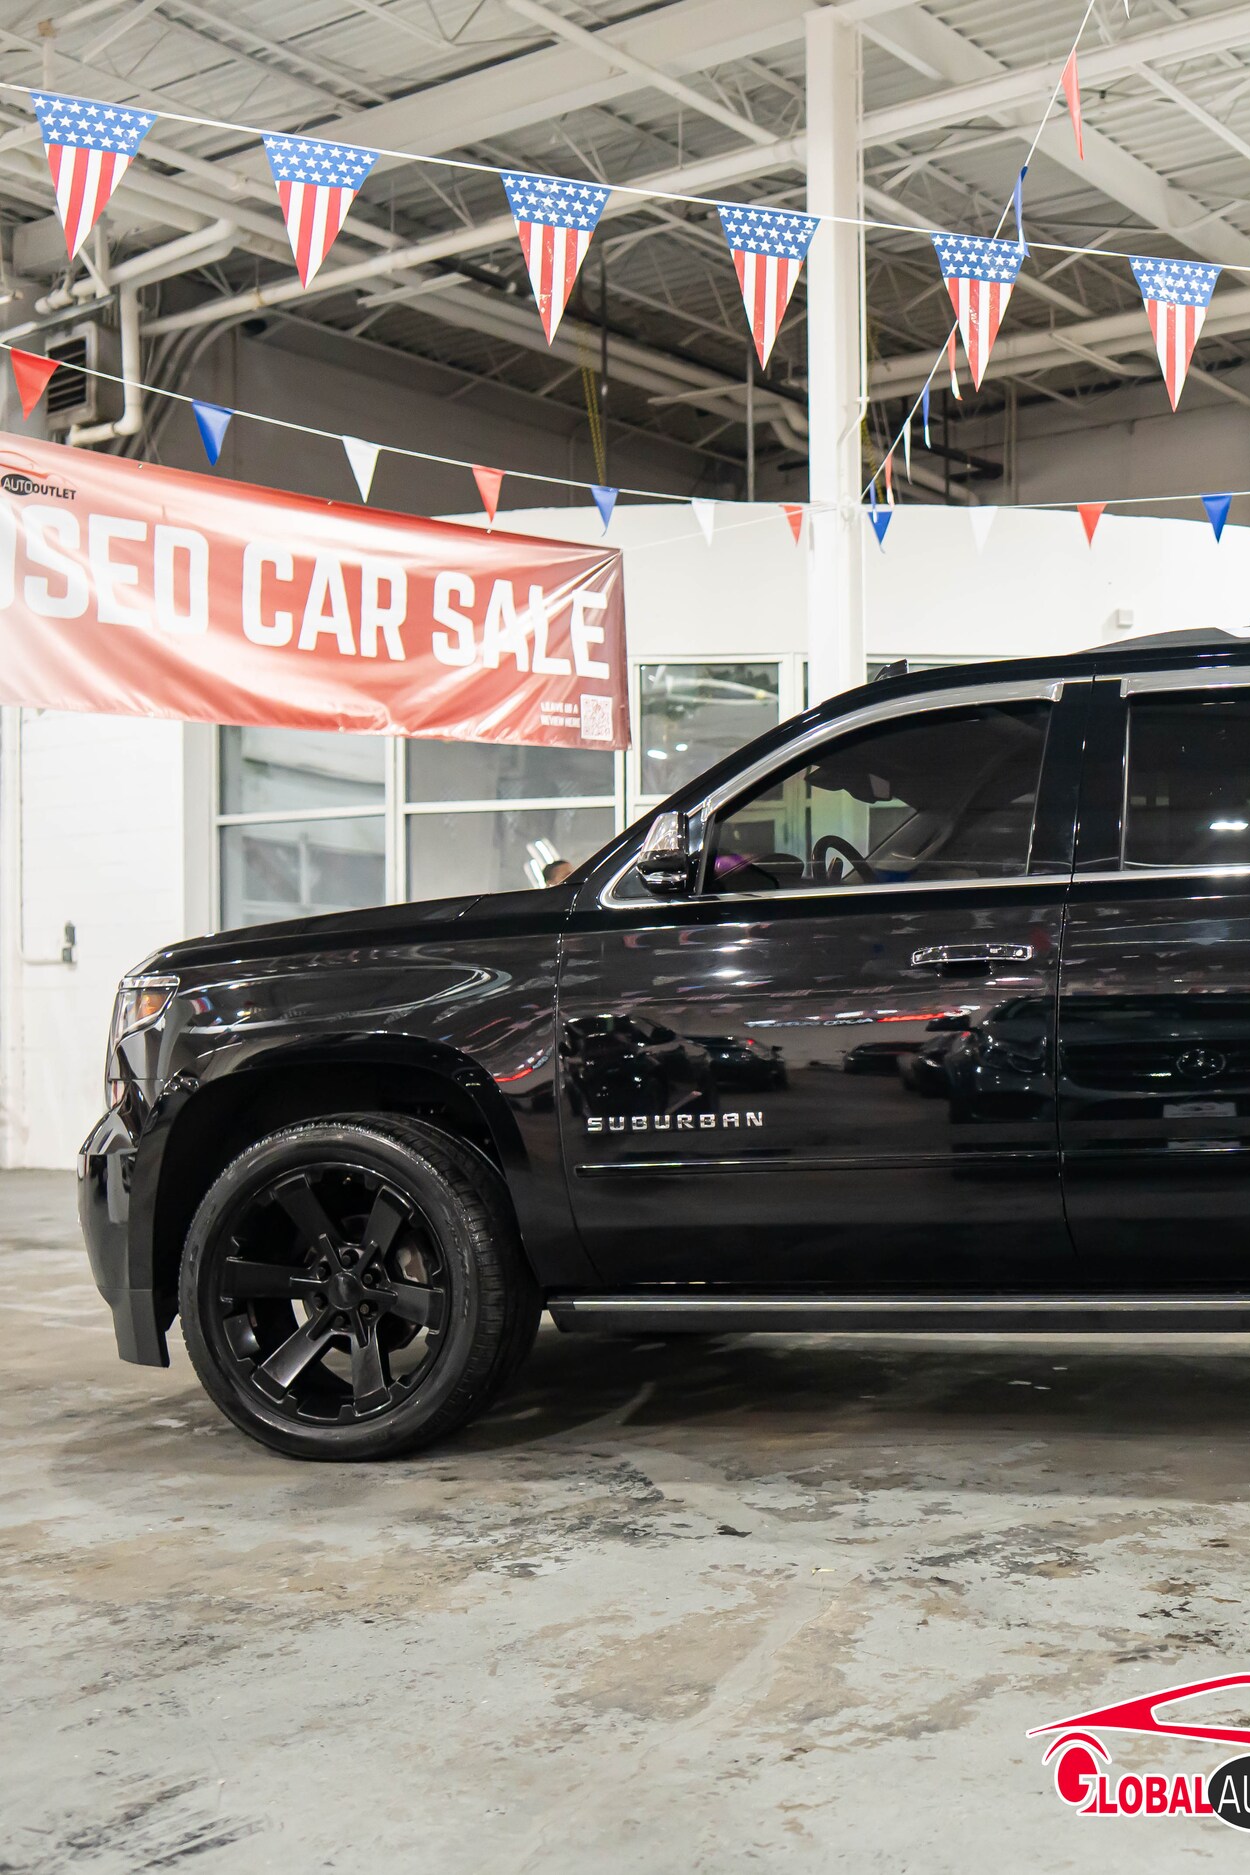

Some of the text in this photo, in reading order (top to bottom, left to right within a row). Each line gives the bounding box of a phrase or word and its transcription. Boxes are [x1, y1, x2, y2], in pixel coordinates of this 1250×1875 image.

[0, 497, 610, 680] SED CAR SALE
[587, 1111, 763, 1132] SUBURBAN
